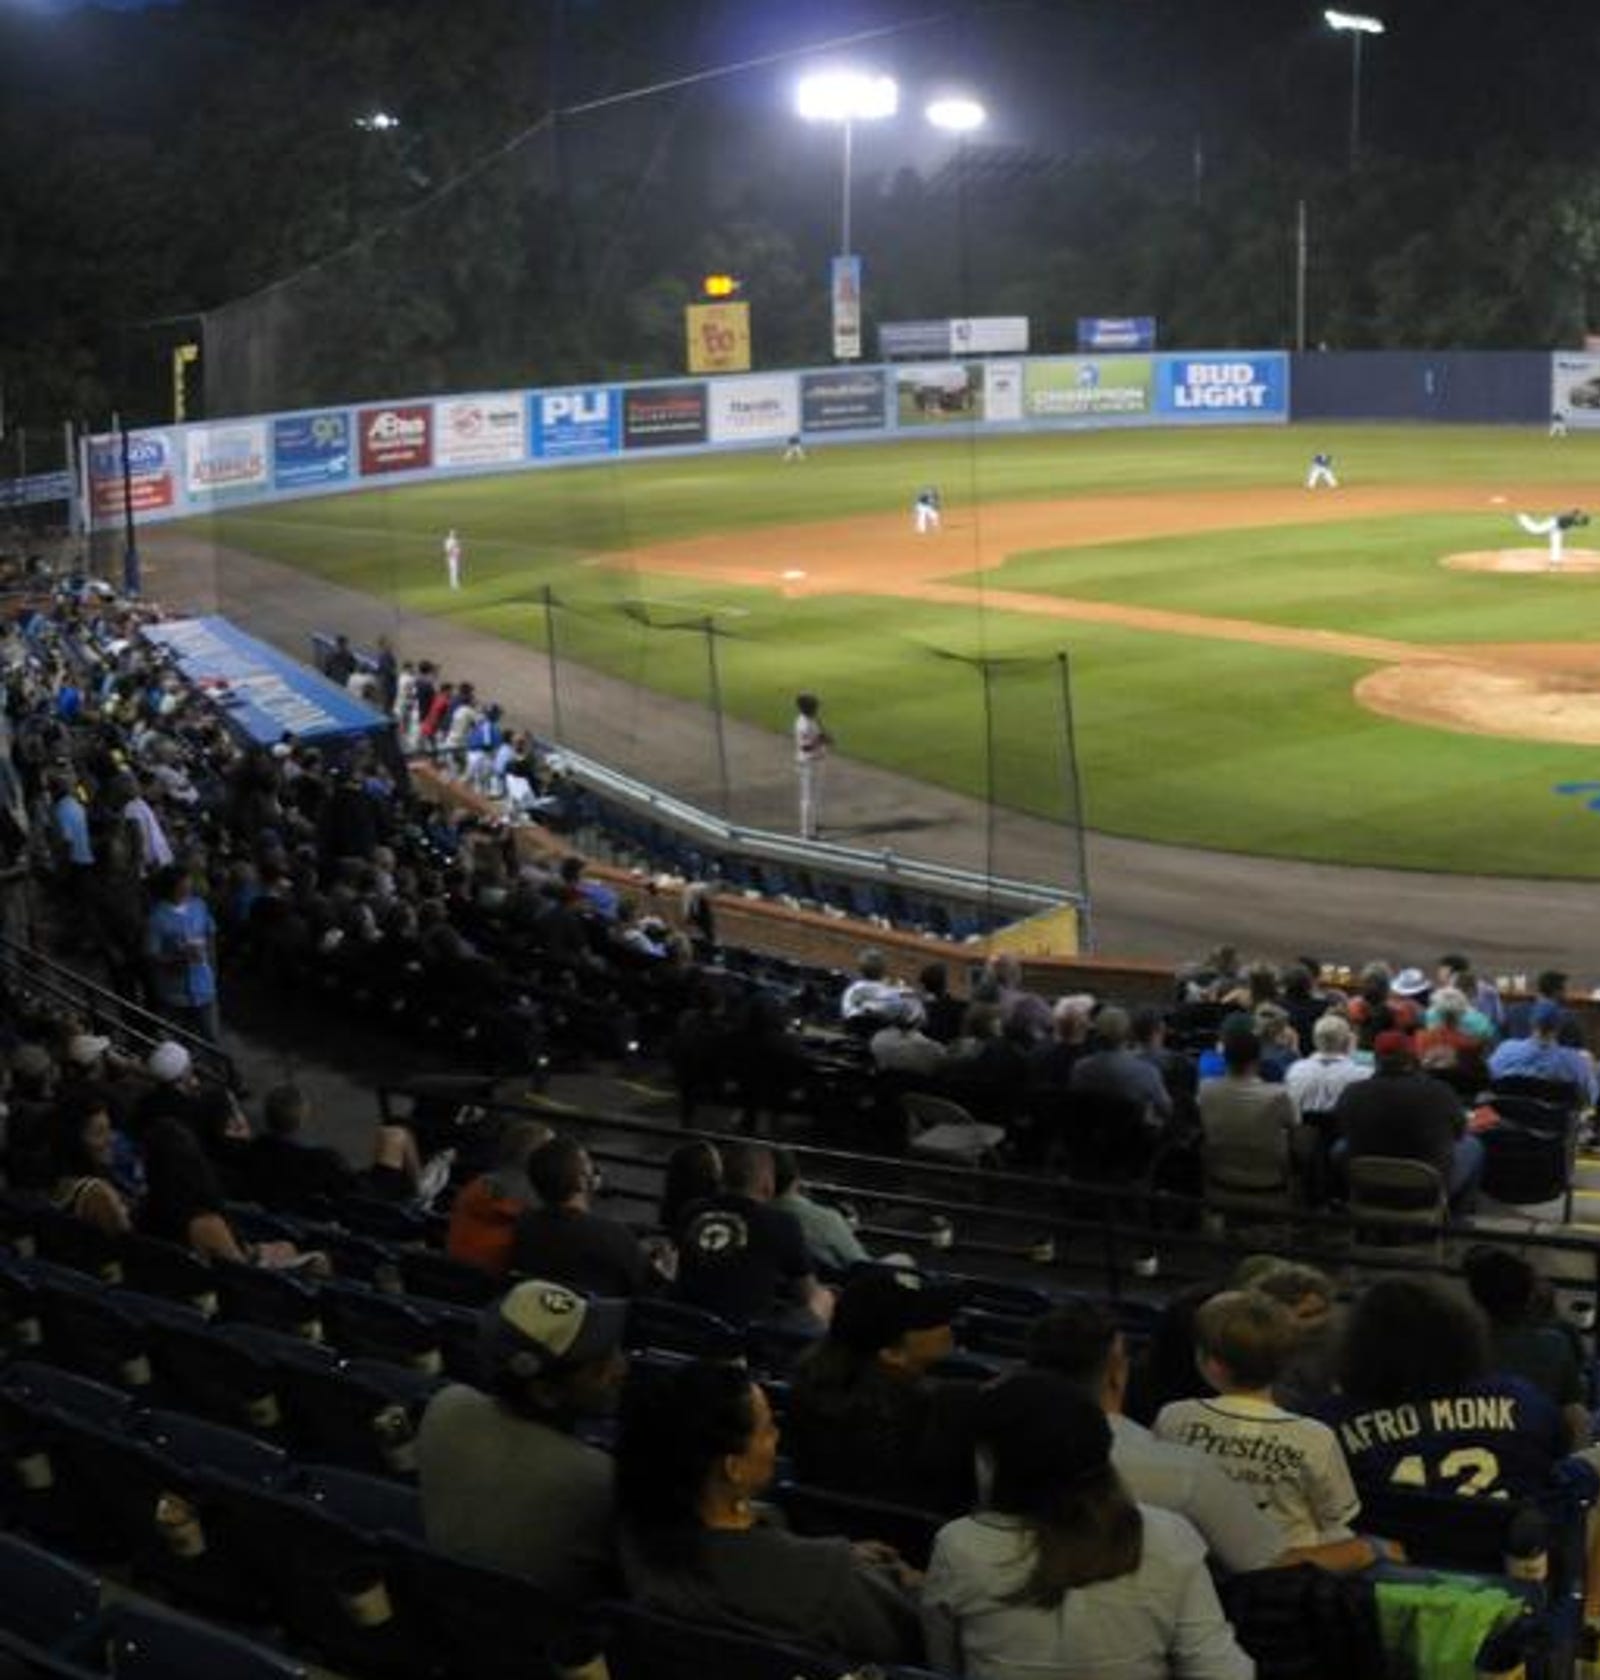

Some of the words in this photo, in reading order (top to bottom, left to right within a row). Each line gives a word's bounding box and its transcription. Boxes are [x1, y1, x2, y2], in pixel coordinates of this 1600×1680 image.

[1187, 362, 1254, 384] BUD
[1174, 385, 1267, 408] LIGHT
[1339, 1407, 1421, 1455] AFRO
[1432, 1397, 1517, 1433] MONK
[1186, 1421, 1305, 1471] Prestige
